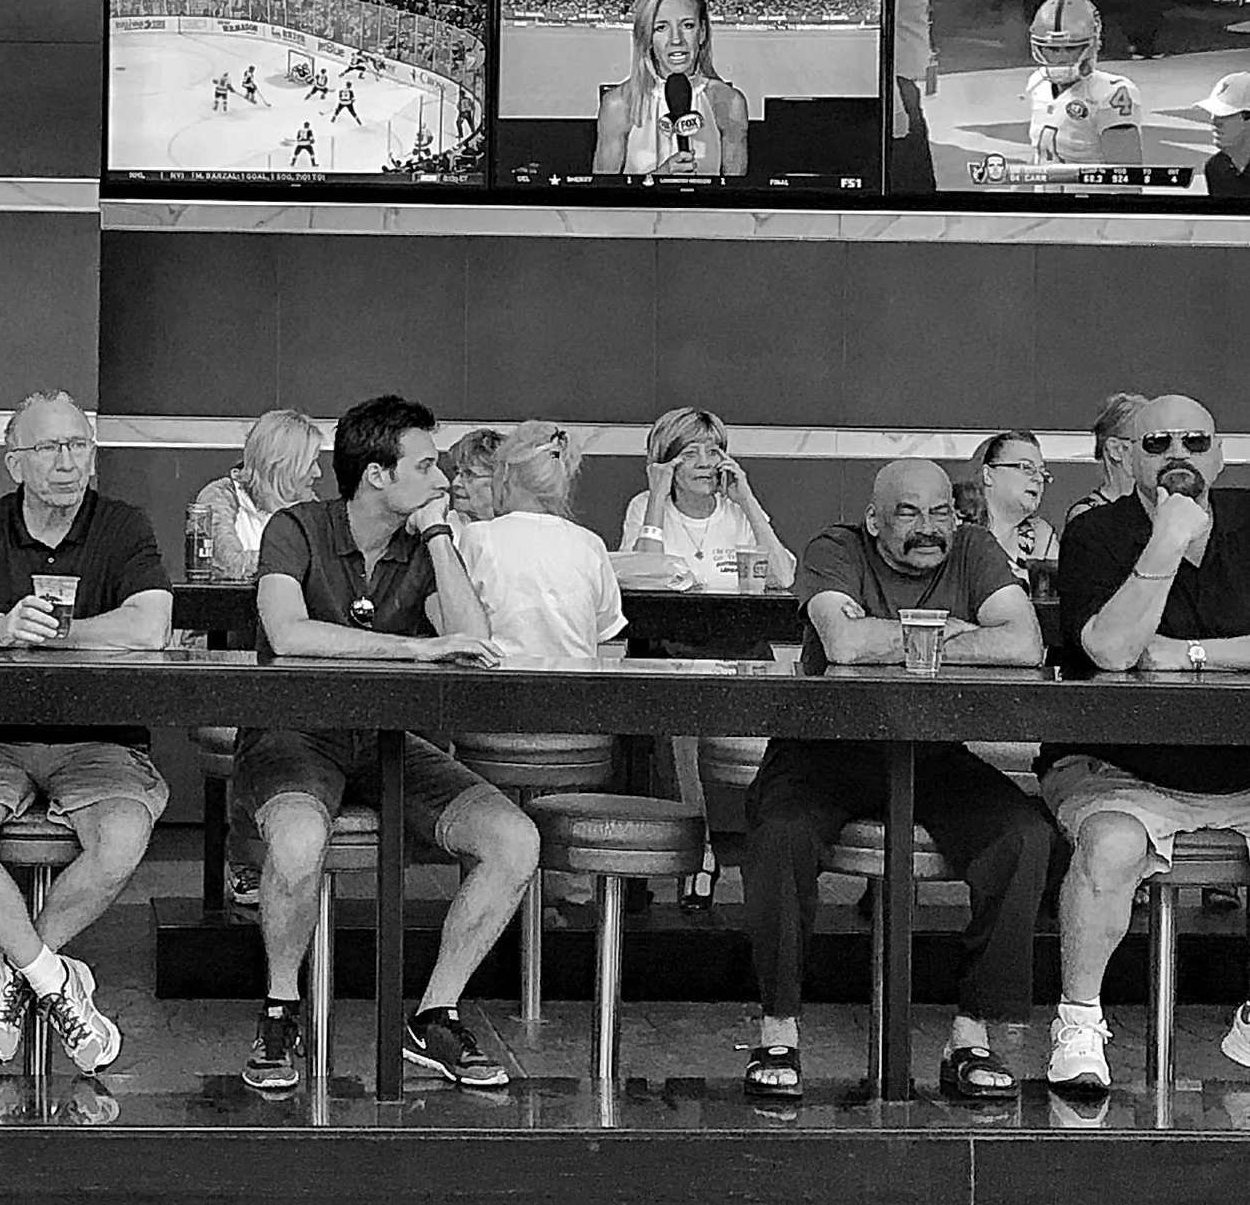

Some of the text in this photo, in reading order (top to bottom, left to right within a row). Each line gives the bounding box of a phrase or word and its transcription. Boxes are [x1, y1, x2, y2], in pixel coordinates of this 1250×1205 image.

[1109, 85, 1134, 116] 4
[680, 118, 699, 128] FOX
[840, 178, 862, 188] FS1
[1024, 174, 1047, 182] CARR
[1112, 175, 1129, 183] 924
